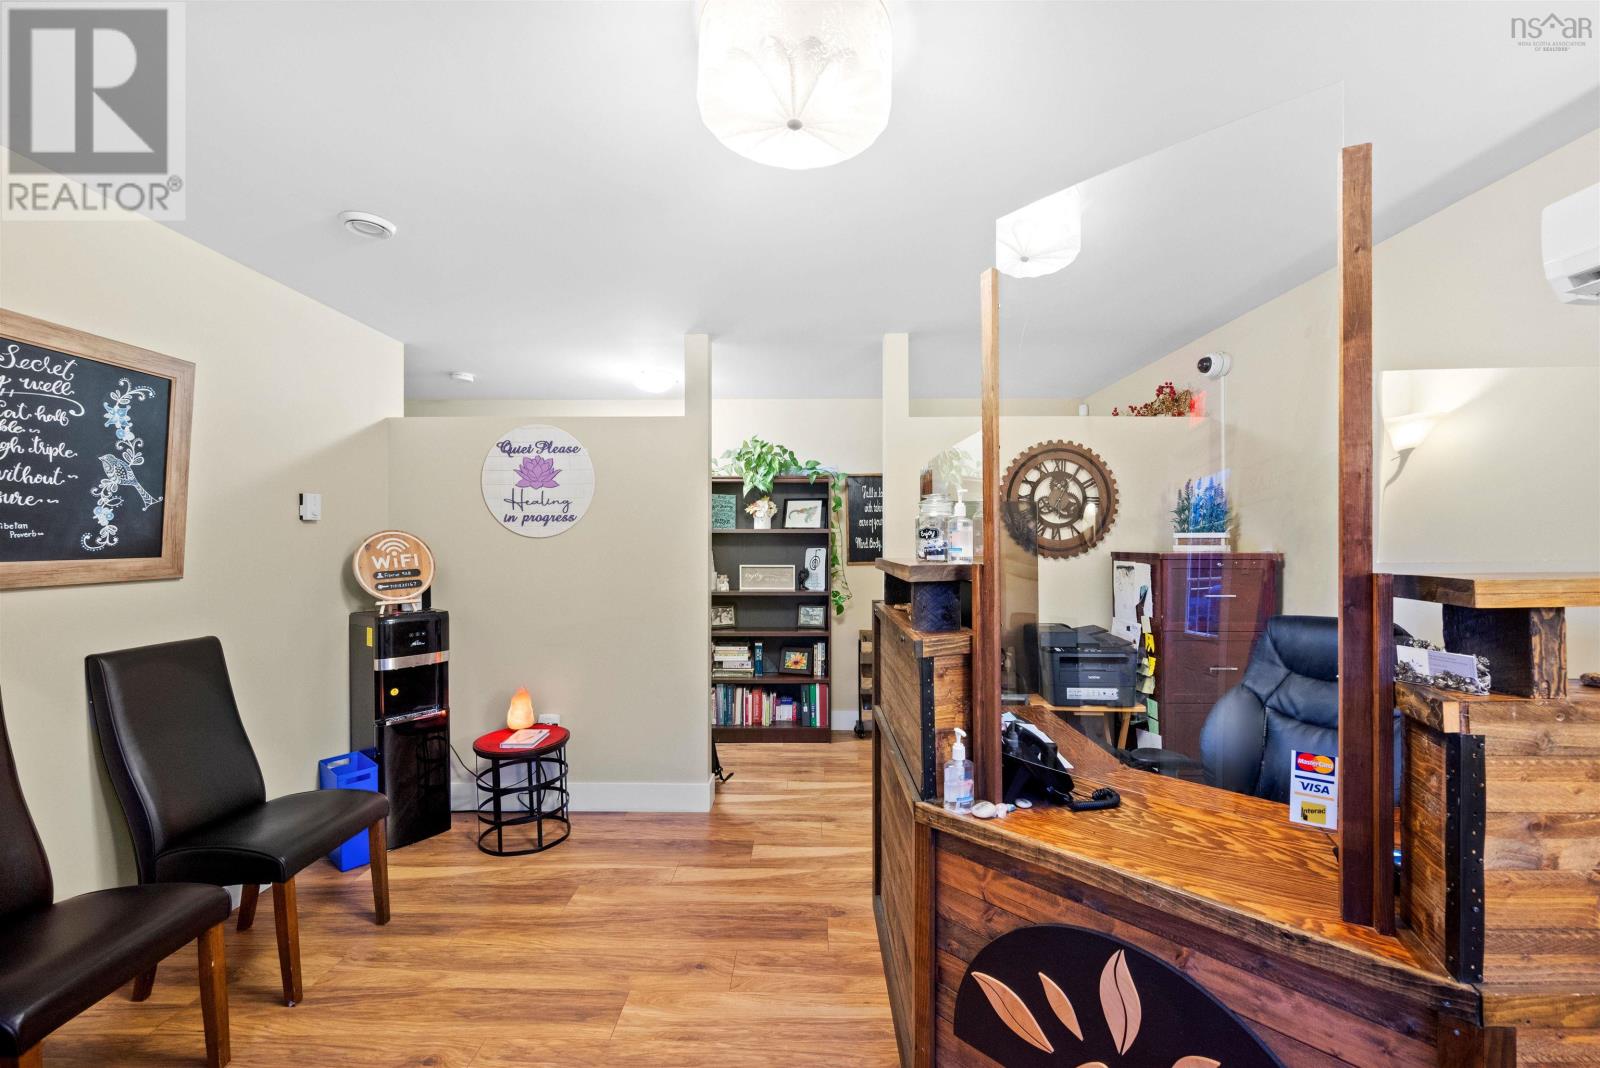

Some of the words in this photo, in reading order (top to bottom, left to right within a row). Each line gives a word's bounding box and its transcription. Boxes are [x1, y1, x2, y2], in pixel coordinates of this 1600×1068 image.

[1, 344, 78, 381] Secret
[19, 378, 75, 395] well
[34, 405, 69, 427] half
[28, 435, 78, 463] triple
[496, 440, 534, 458] Quiet
[535, 441, 581, 454] Please
[503, 488, 573, 513] Healing
[0, 522, 28, 530] ibetan
[503, 513, 518, 523] in
[520, 513, 577, 527] progress
[9, 530, 37, 539] Proverb
[1300, 781, 1330, 795] VISA
